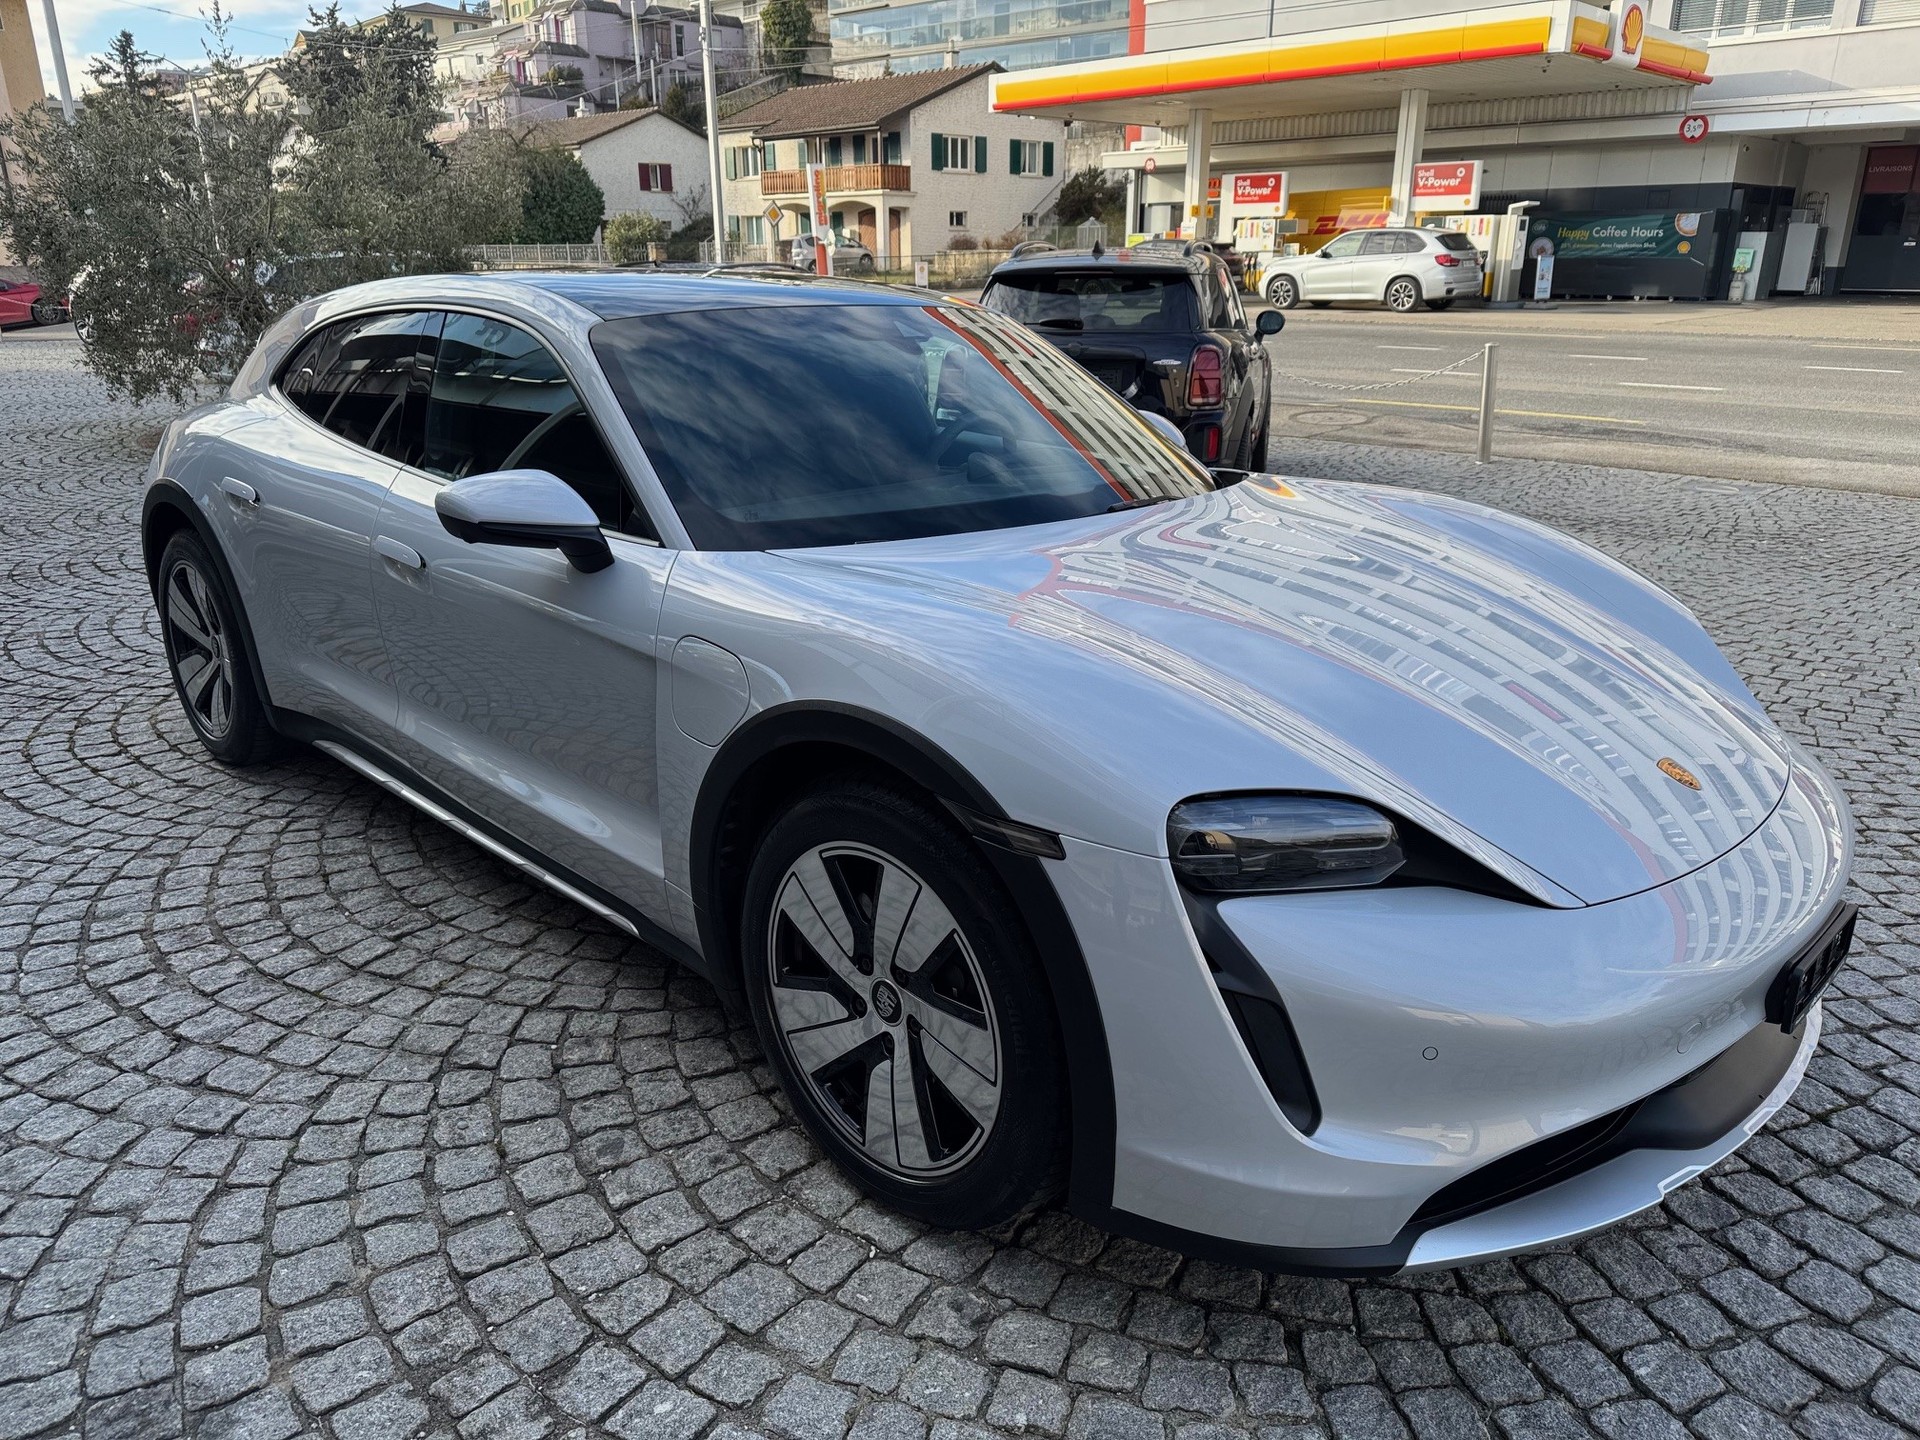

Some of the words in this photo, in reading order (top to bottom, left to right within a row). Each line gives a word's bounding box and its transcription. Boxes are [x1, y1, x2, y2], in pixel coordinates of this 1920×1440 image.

[1417, 169, 1435, 177] Shell
[1418, 177, 1462, 187] V-Power
[1237, 186, 1272, 196] V-Power
[1557, 227, 1590, 240] Happy
[1592, 225, 1628, 238] Coffee
[1631, 226, 1664, 238] Hours
